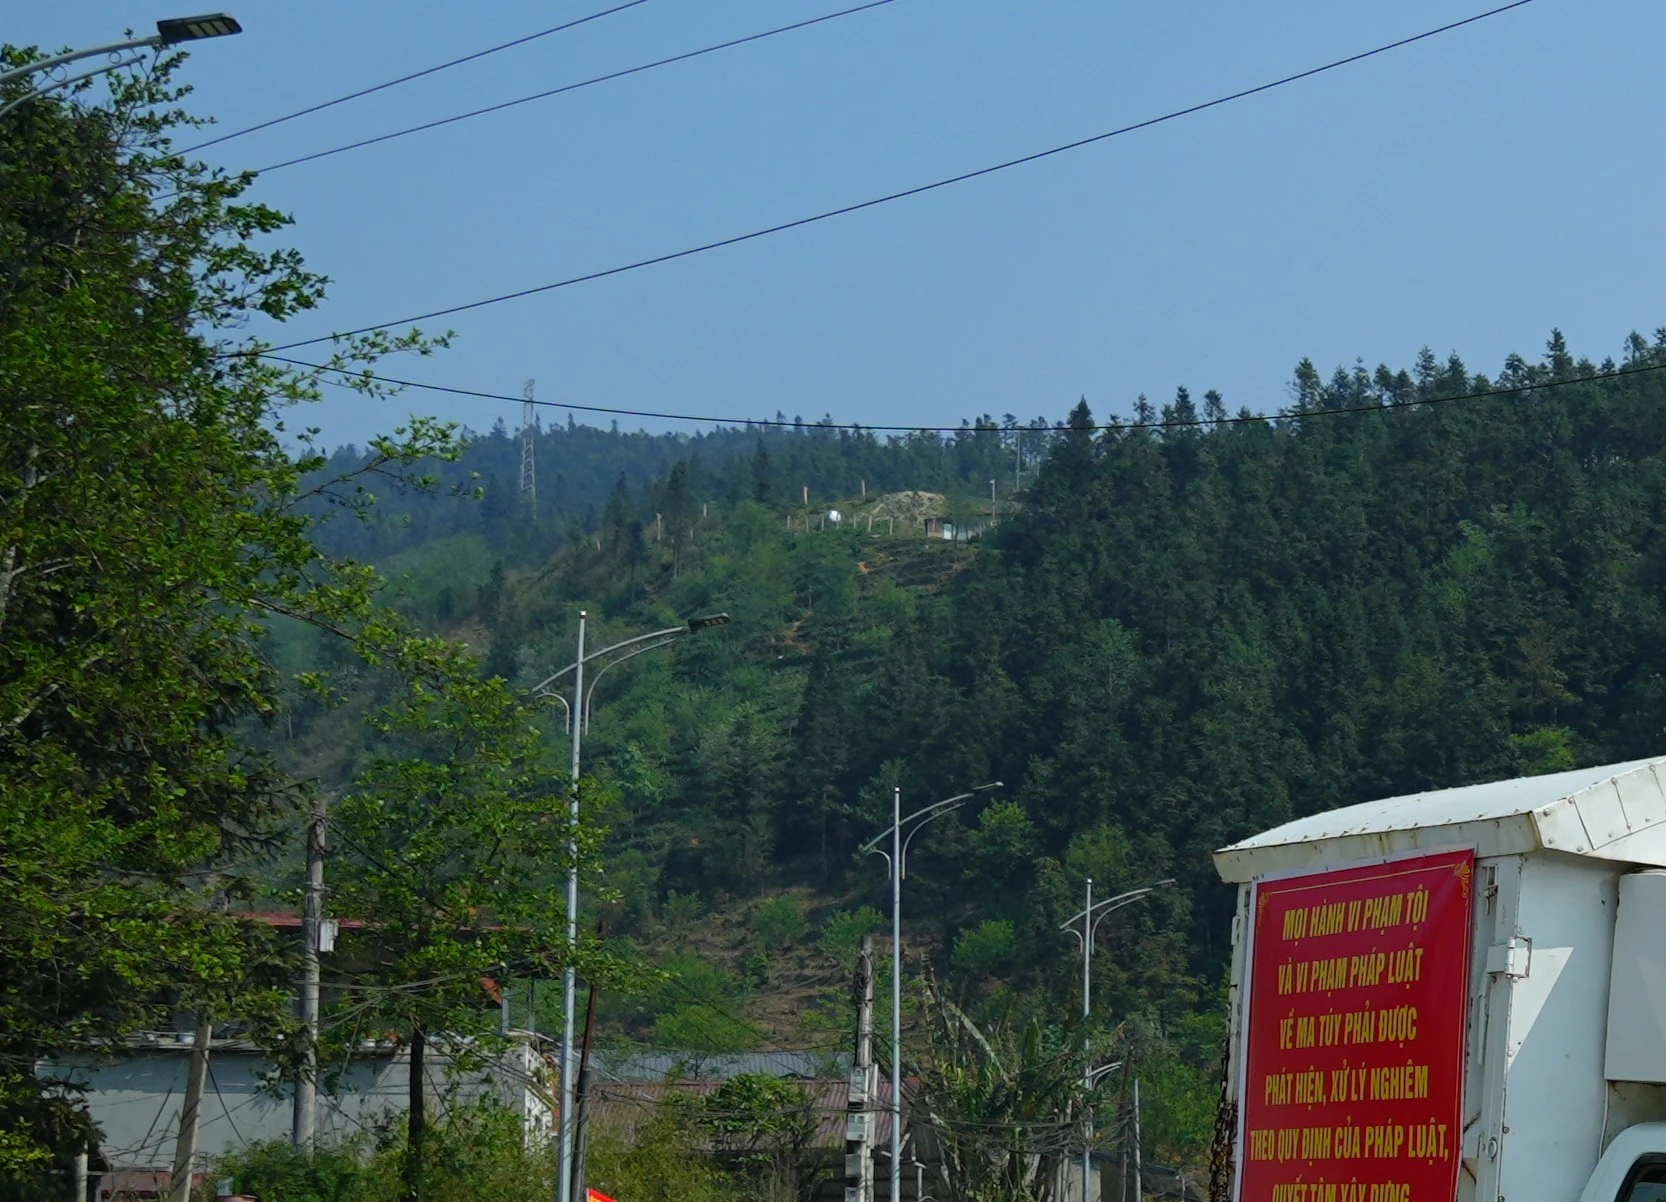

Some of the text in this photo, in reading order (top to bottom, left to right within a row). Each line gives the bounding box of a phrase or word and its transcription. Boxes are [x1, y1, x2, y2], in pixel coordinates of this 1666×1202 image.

[1283, 884, 1429, 946] MỌI HÀNH VI PHẠM TỘI
[1278, 942, 1423, 997] VÀ VI PHẠM PHÁP LUẬT
[1280, 1000, 1418, 1050] VỀ MA TÚY PHẢI ĐƯỢC
[1265, 1059, 1428, 1110] PHÁT HIỆN, XỬ LÝ NGHIÊM
[1250, 1115, 1449, 1166] THEO QUY ĐỊNH CỦA PHÁP LUẬT,
